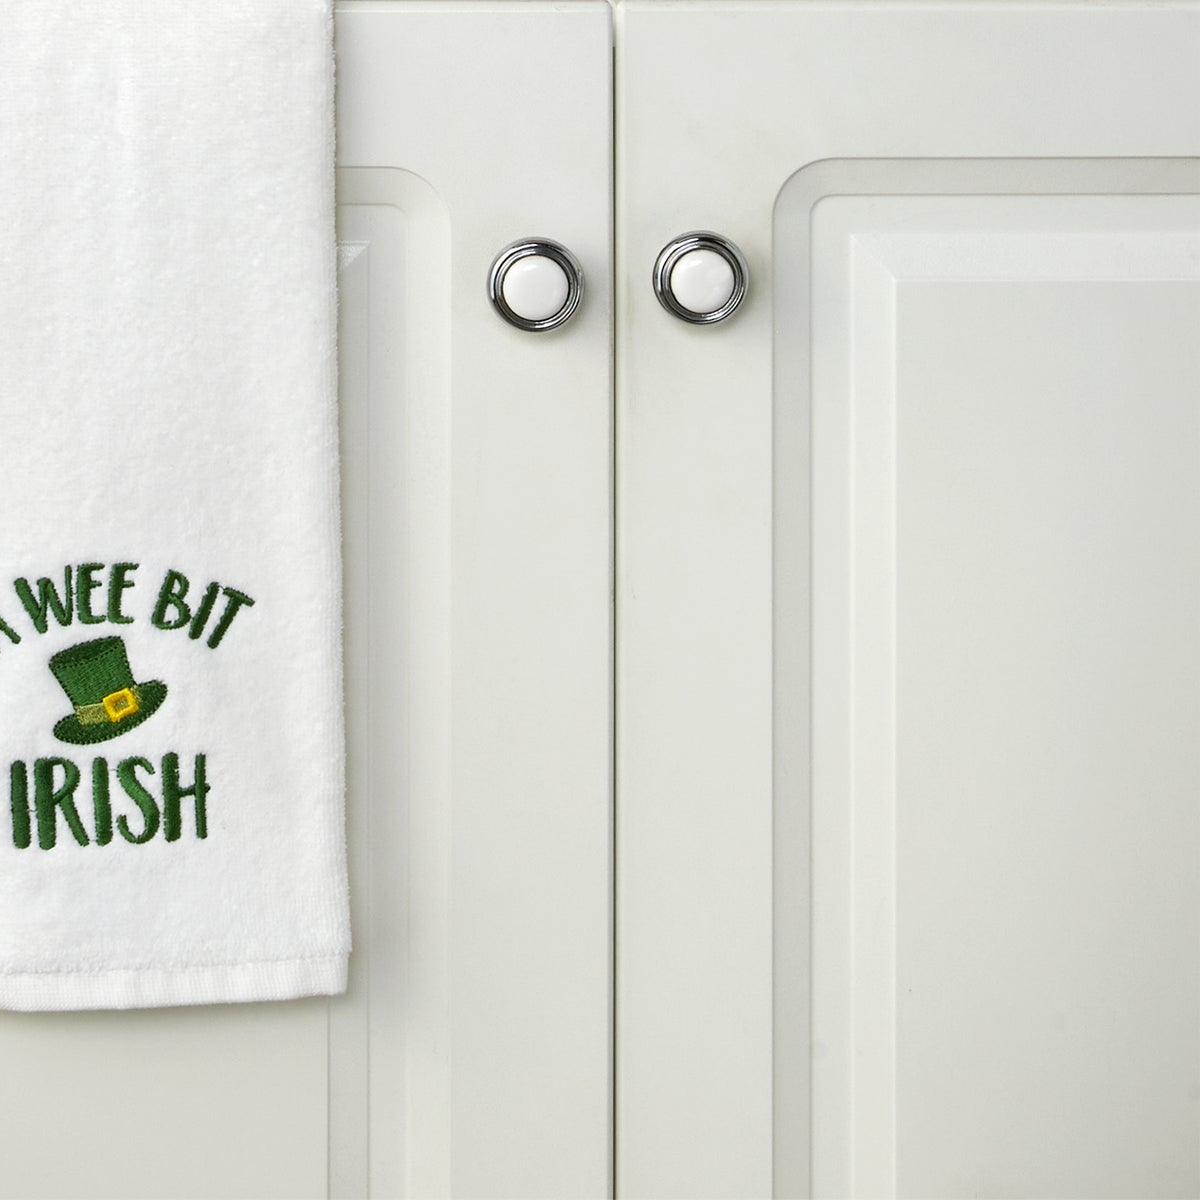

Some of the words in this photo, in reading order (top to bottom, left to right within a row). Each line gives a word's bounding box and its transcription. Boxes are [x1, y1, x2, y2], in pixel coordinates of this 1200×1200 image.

[13, 561, 140, 635] WEE
[150, 568, 256, 650] BIT
[9, 751, 212, 851] IRISH
